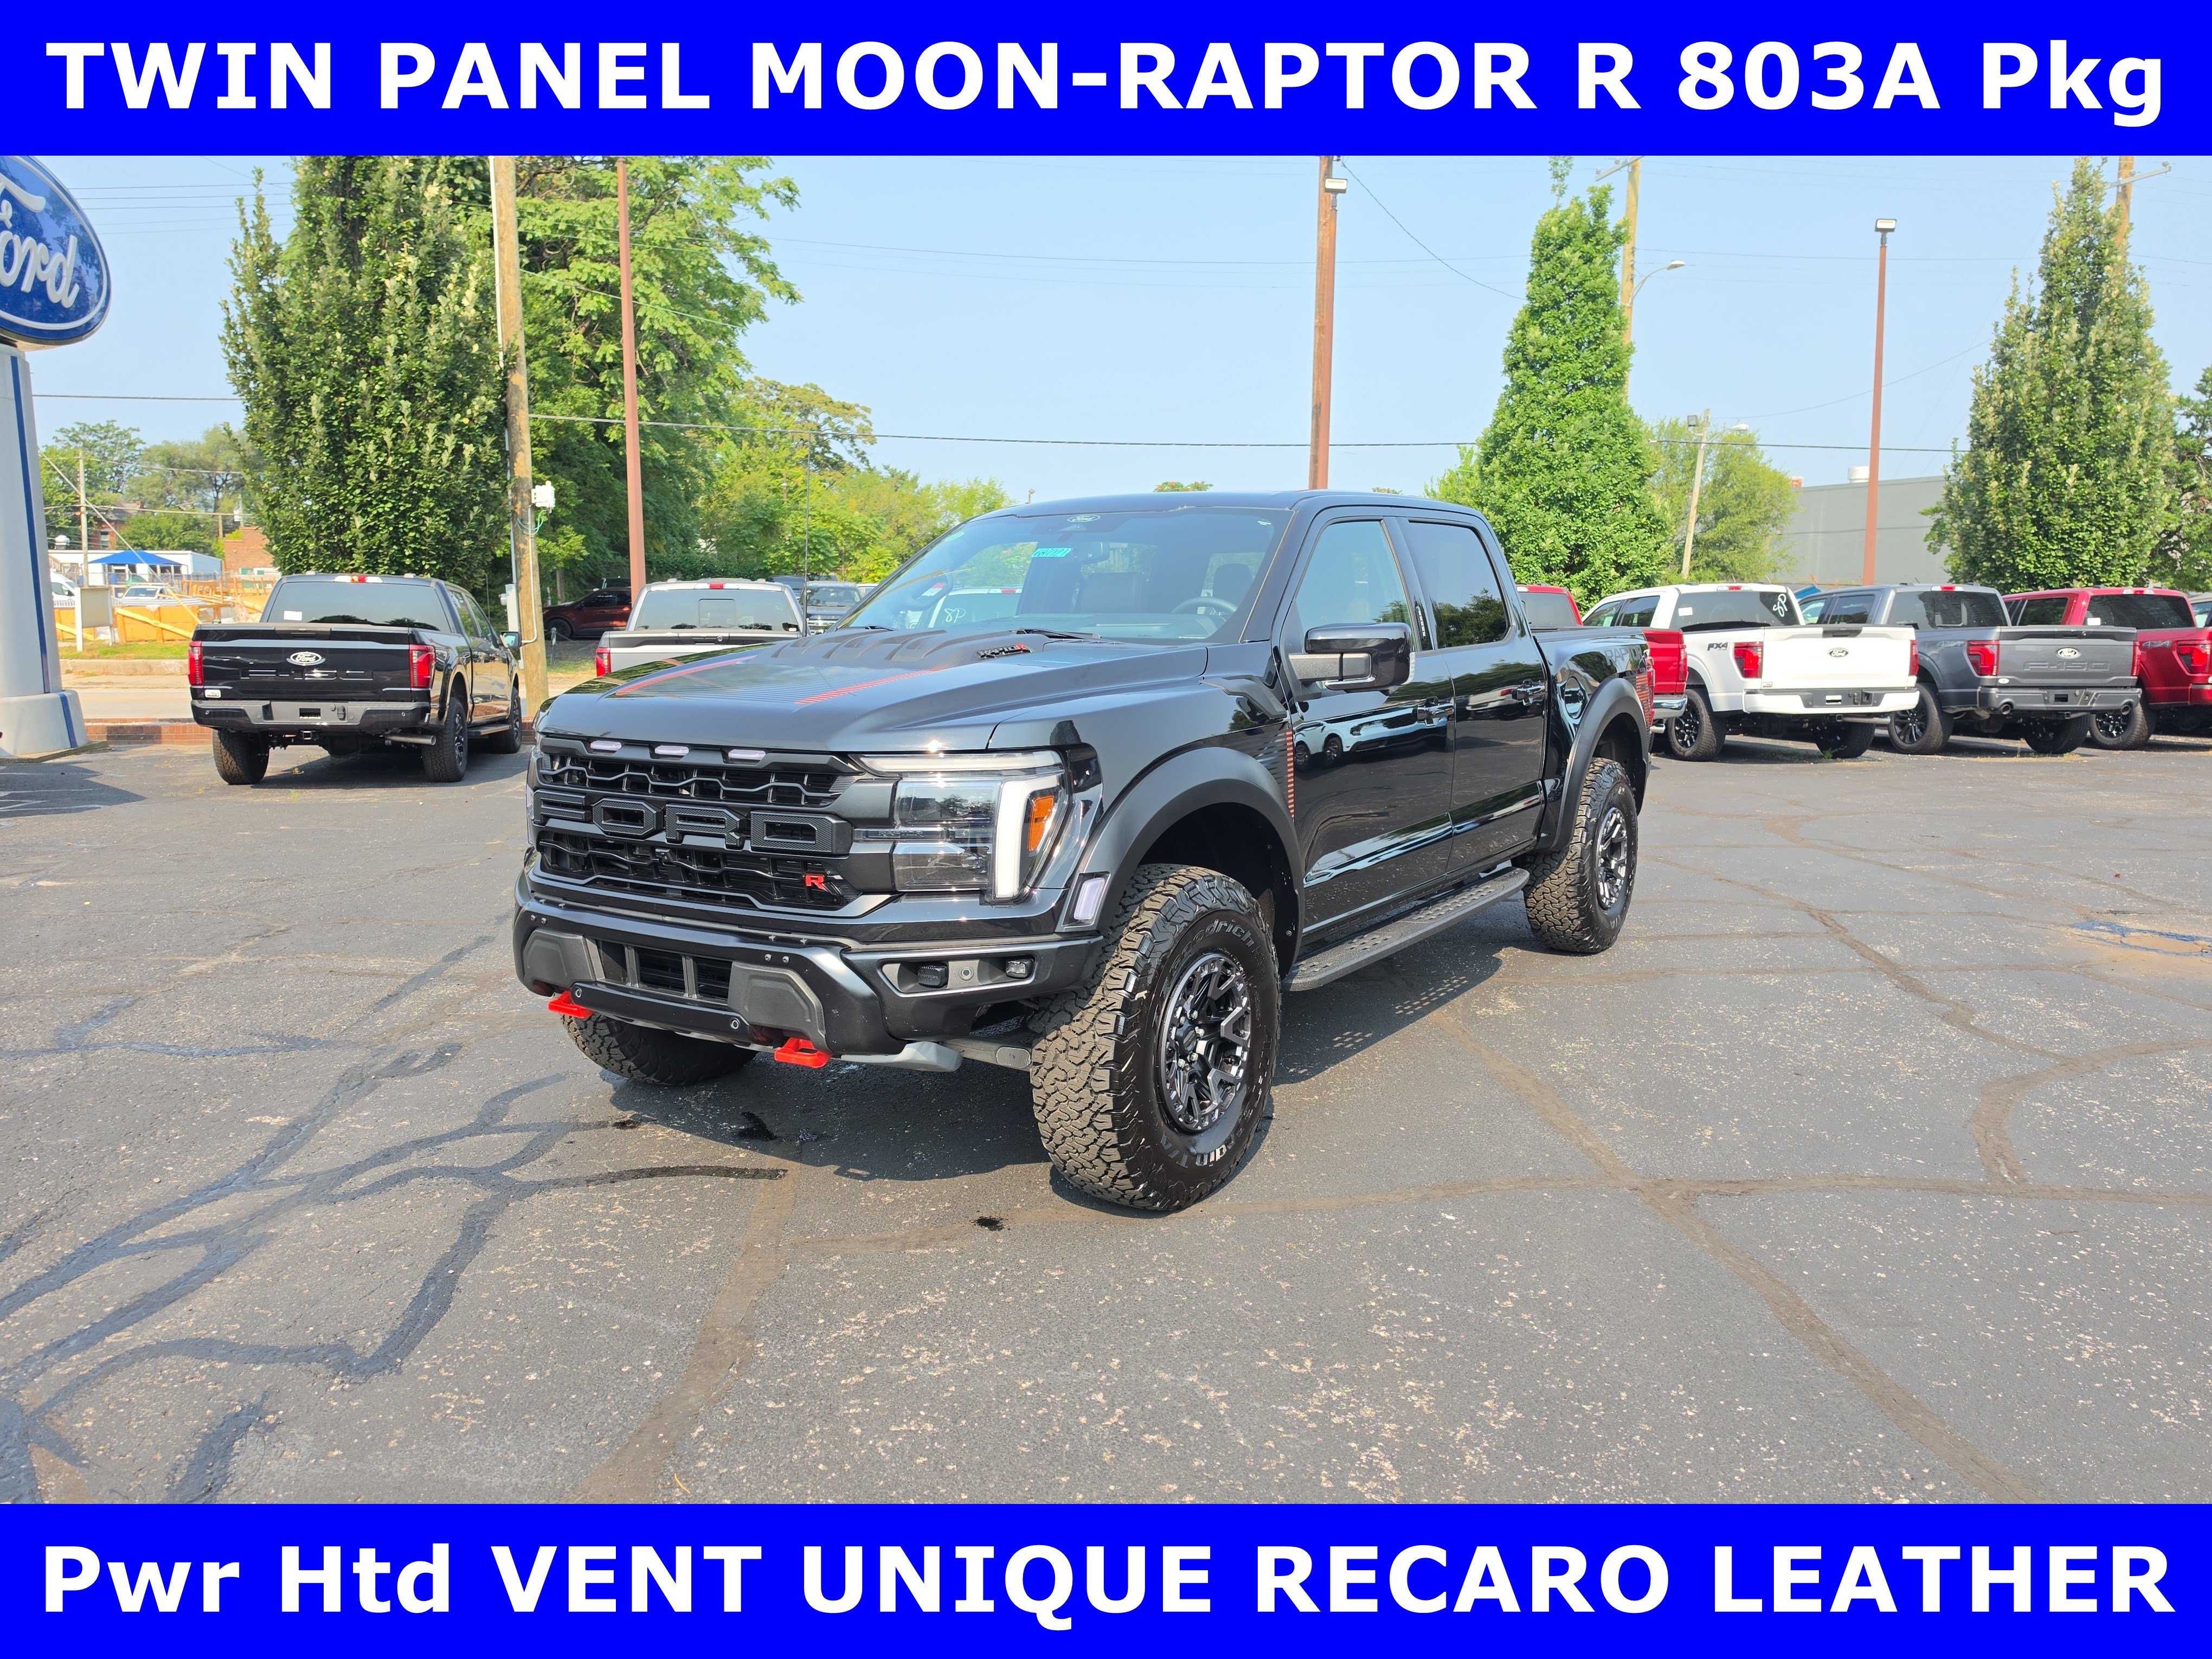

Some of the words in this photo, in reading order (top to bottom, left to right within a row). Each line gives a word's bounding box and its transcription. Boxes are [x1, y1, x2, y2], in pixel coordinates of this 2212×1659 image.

[1605, 644, 1642, 666] RAPTOR
[1707, 642, 1728, 651] FX4
[2023, 661, 2110, 671] F-150
[533, 789, 847, 854] FORD
[805, 873, 828, 892] R
